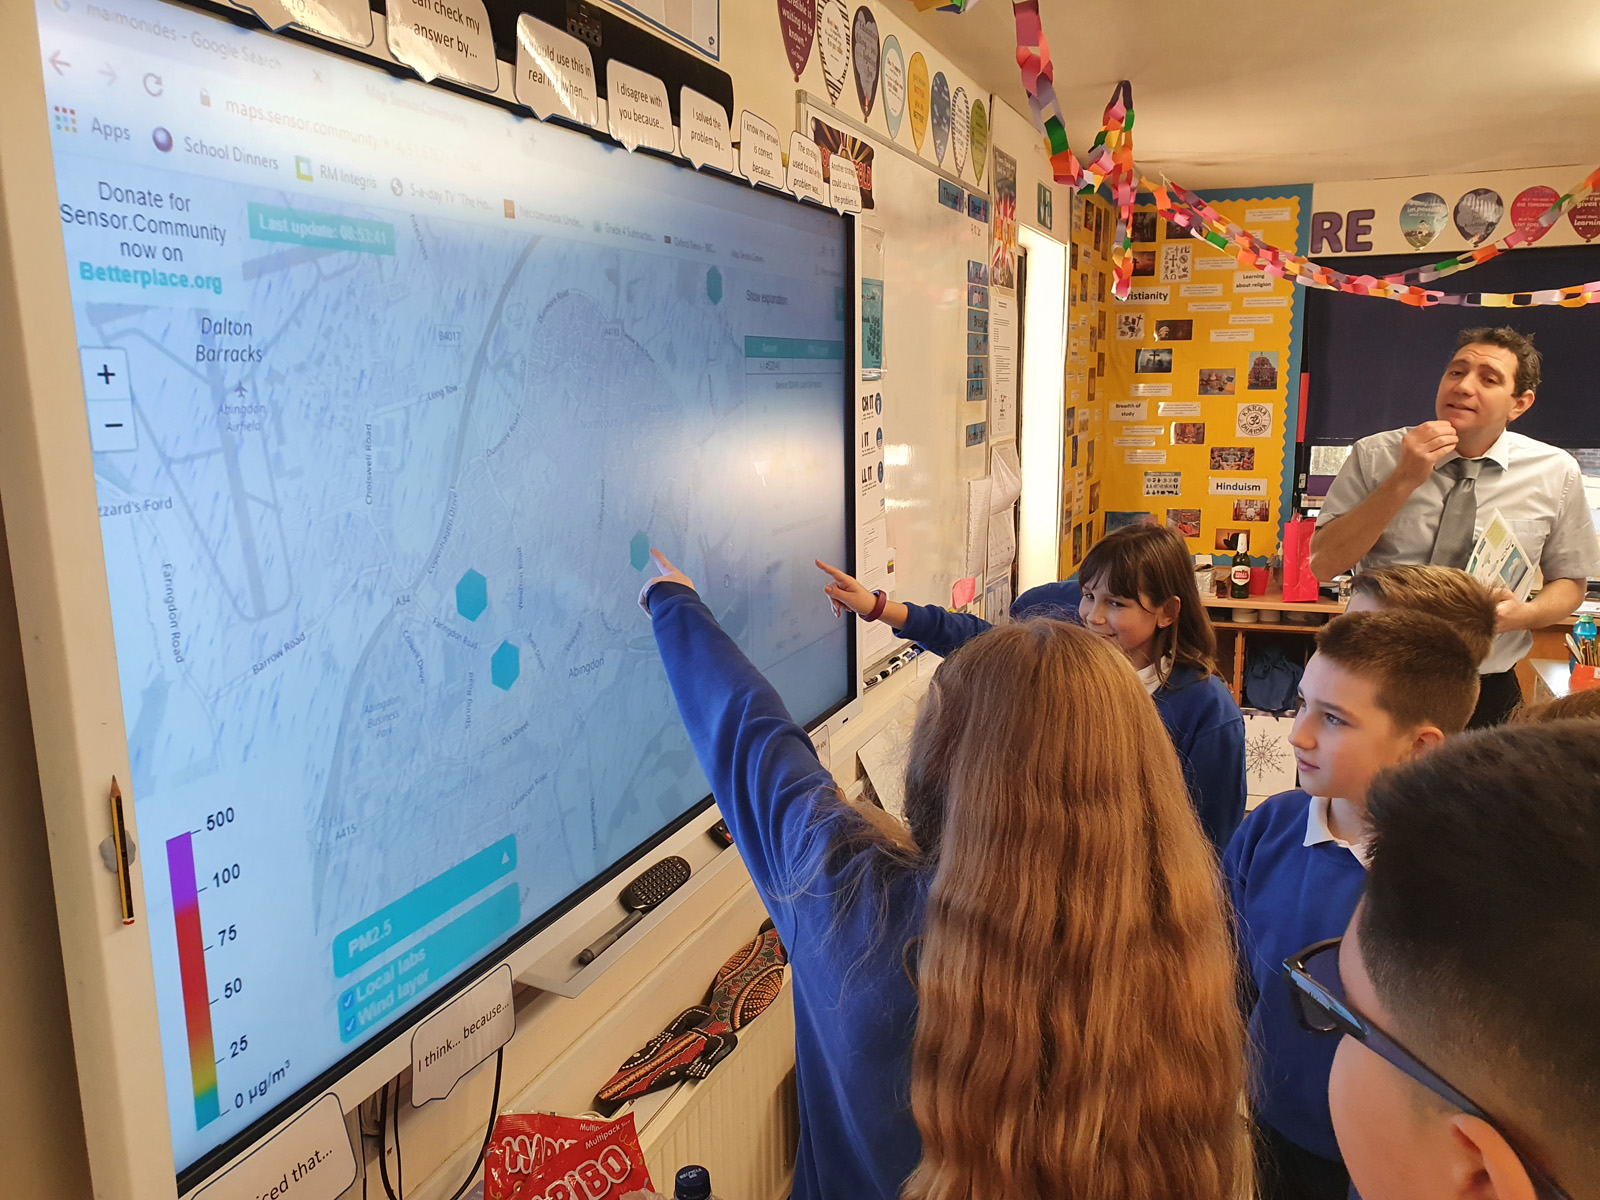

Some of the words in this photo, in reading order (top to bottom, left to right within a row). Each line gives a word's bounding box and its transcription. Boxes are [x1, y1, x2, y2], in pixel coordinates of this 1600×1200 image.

[434, 0, 464, 24] check
[466, 16, 480, 35] my
[191, 31, 238, 60] Google
[241, 46, 282, 68] Search
[413, 22, 453, 49] answer
[457, 35, 478, 59] by...
[528, 68, 546, 84] real
[556, 51, 570, 68] use
[571, 55, 585, 73] this
[585, 63, 592, 77] in
[620, 83, 648, 103] disagree
[650, 94, 663, 108] with
[91, 118, 131, 142] Apps
[619, 108, 632, 120] you
[634, 108, 664, 130] because...
[696, 110, 712, 126] solved
[713, 117, 721, 130] the
[747, 122, 759, 135] know
[691, 130, 713, 147] problem
[184, 136, 229, 163] School
[233, 146, 280, 171] Dinners
[320, 165, 338, 181] RM
[340, 168, 377, 189] Integris
[793, 177, 811, 193] problem
[98, 181, 164, 208] Donate
[169, 192, 191, 212] for
[60, 204, 226, 245] Sensor.Community
[259, 213, 288, 233] Last
[292, 219, 336, 240] update:
[1310, 208, 1375, 254] RE
[120, 239, 157, 259] now
[162, 246, 184, 262] on
[80, 262, 223, 295] Betterplace.org
[1116, 290, 1169, 301] ristianity
[201, 317, 253, 337] Dalton
[195, 344, 263, 363] Barracks
[1241, 405, 1268, 416] KARMA
[1241, 423, 1267, 434] DHARMA
[1216, 482, 1261, 492] Hinduism
[144, 497, 173, 511] Ford
[395, 594, 411, 607] A34
[163, 563, 179, 628] Faringdon
[171, 631, 184, 663] Road
[432, 617, 463, 642] Faringdon
[463, 636, 478, 650] Road
[251, 650, 284, 675] Barrow
[283, 632, 306, 653] Road
[568, 656, 605, 679] Abingdon
[207, 807, 235, 831] 500
[212, 863, 241, 889] 100
[218, 924, 238, 947] 75
[348, 918, 393, 958] PM2.5
[356, 966, 396, 1001] Local
[398, 948, 426, 975] labs
[224, 977, 243, 999] 50
[357, 995, 395, 1026] Wind
[399, 967, 431, 1001] layer
[230, 1034, 249, 1060] 25
[424, 1039, 461, 1070] think...
[462, 1001, 510, 1039] because...
[234, 1091, 245, 1110] 0
[579, 1122, 602, 1133] Multip
[585, 1124, 620, 1150] Multipack
[255, 1174, 288, 1200] iced
[291, 1149, 333, 1180] that...
[530, 1144, 632, 1200] RIBO
